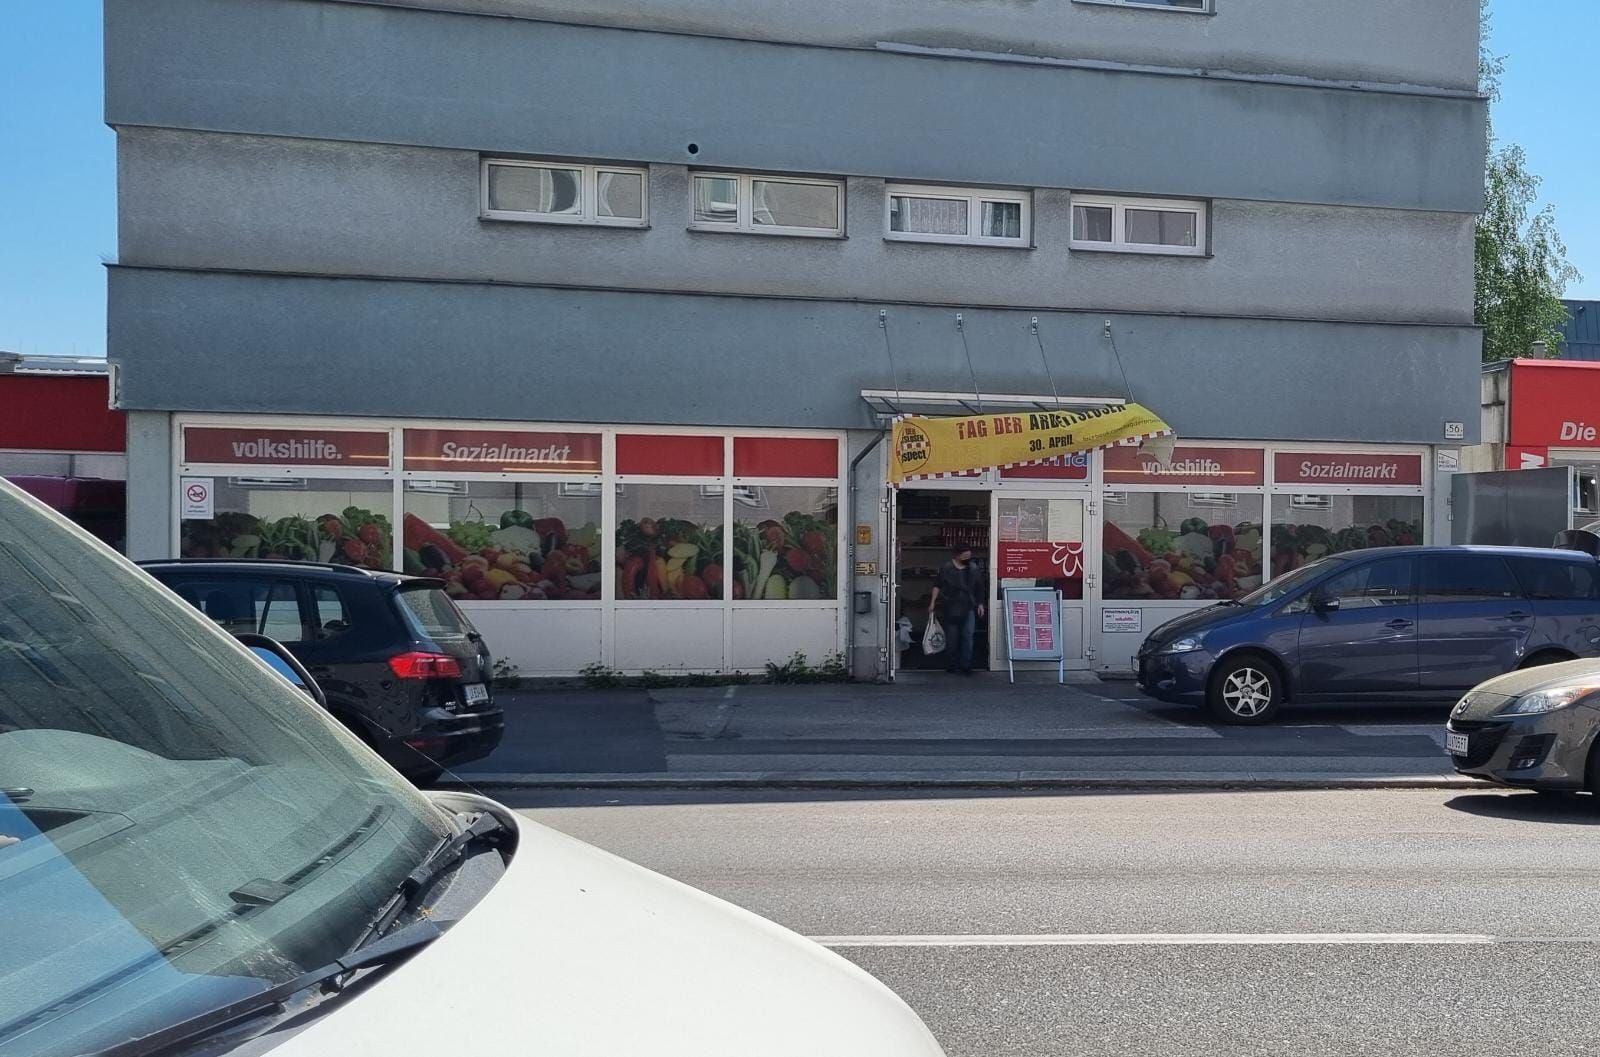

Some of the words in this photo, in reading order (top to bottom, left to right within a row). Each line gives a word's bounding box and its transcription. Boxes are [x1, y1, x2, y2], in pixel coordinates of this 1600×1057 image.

[956, 420, 988, 440] TAG
[993, 417, 1023, 436] DER
[1449, 424, 1460, 433] 56
[1560, 421, 1597, 441] Die
[232, 439, 343, 459] volkshilfe.
[440, 441, 571, 464] Sozialmarkt
[1029, 439, 1046, 453] 30.
[1048, 434, 1074, 449] APRIL
[1299, 461, 1398, 479] Sozialmarkt
